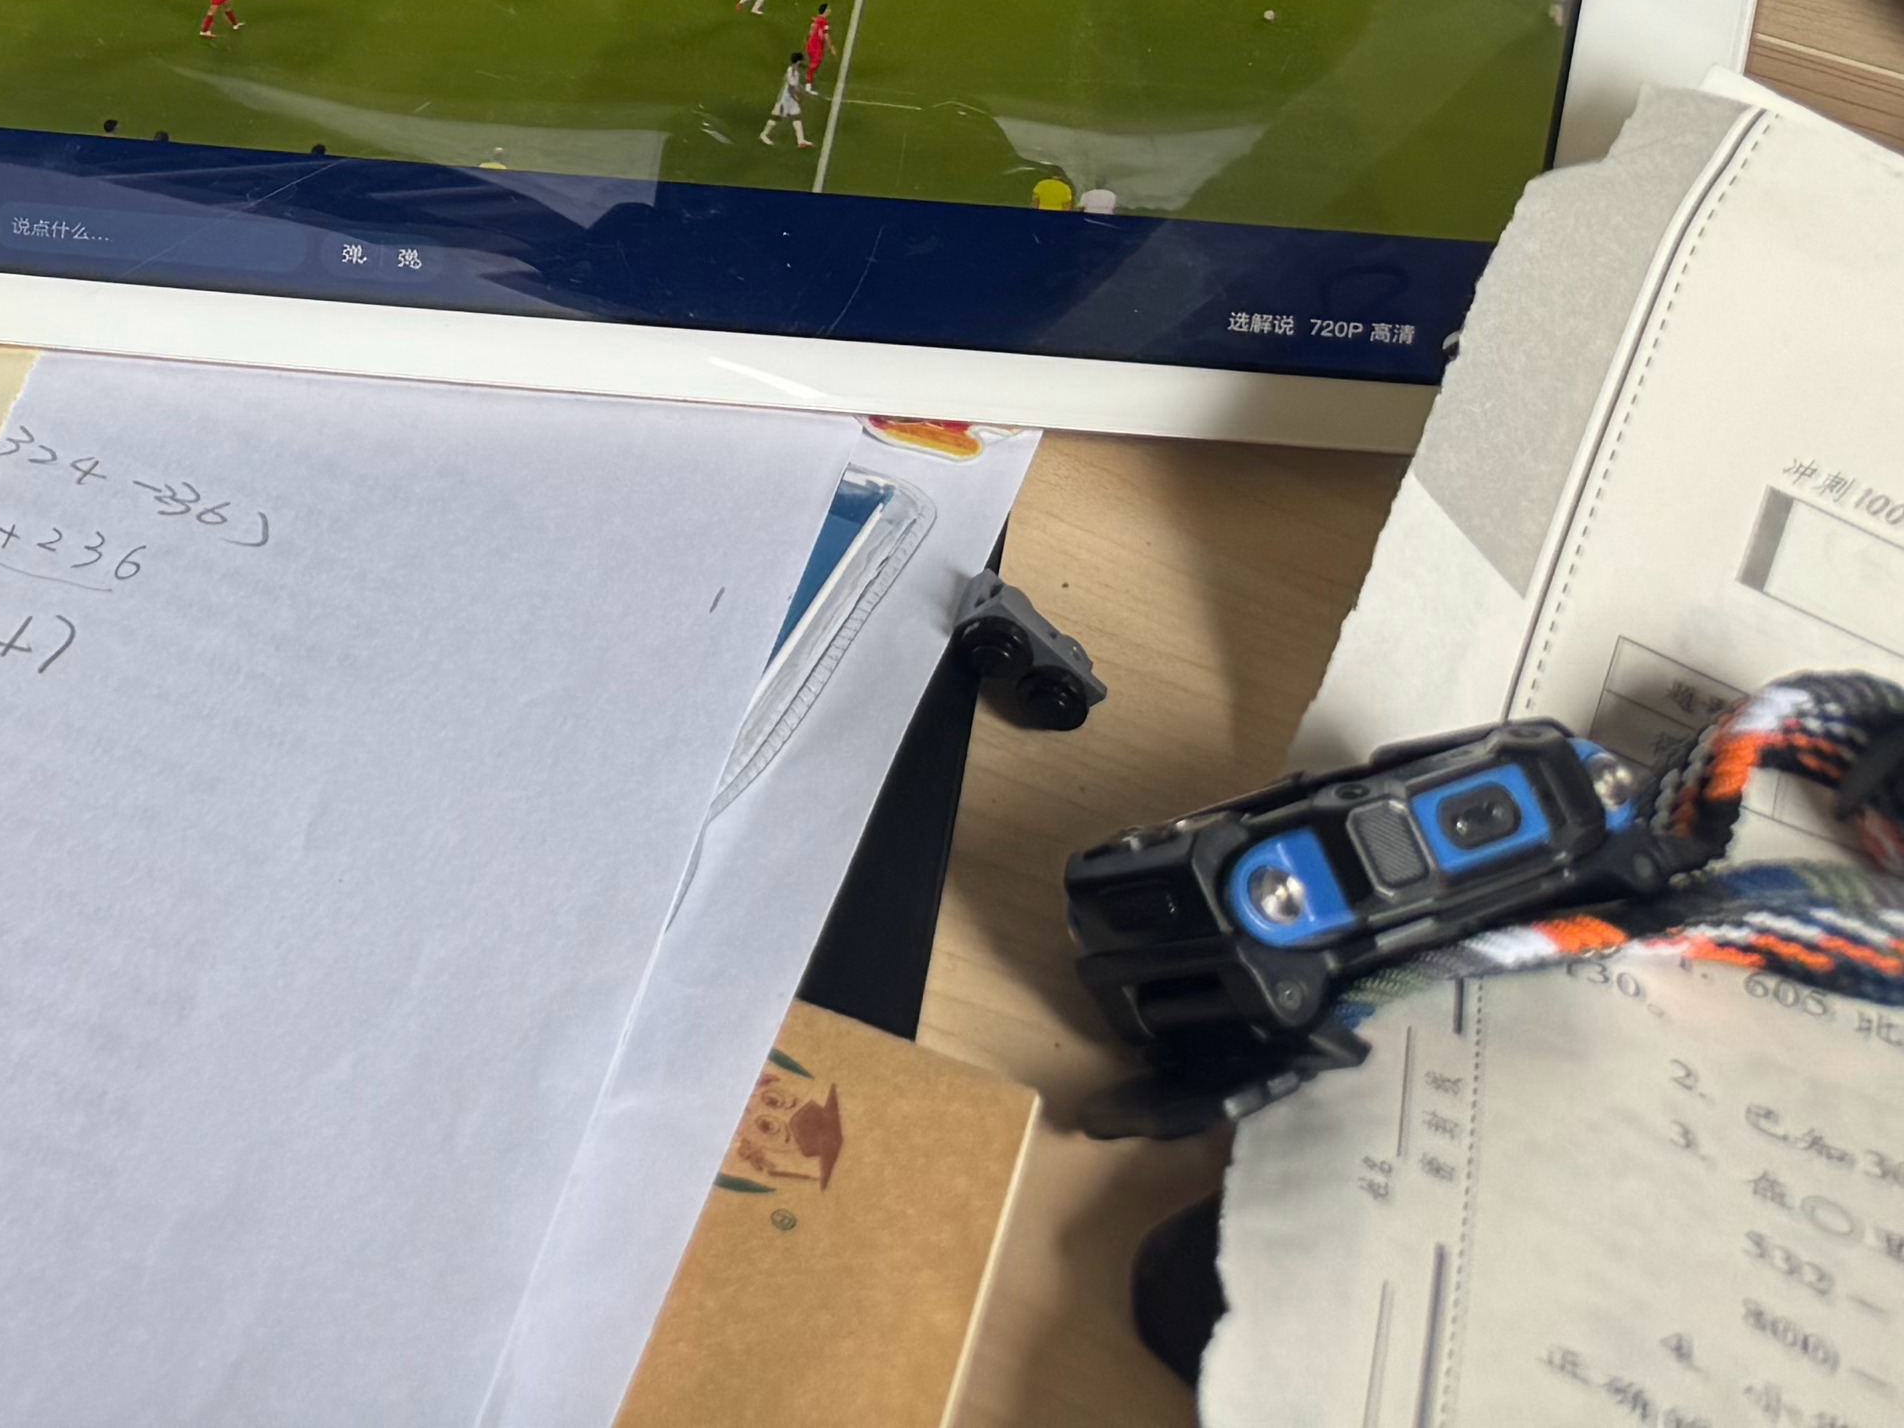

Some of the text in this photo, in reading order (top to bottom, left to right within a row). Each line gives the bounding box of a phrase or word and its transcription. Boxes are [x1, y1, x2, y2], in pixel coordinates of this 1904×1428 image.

[1227, 310, 1415, 344] 选解说 720P 高清
